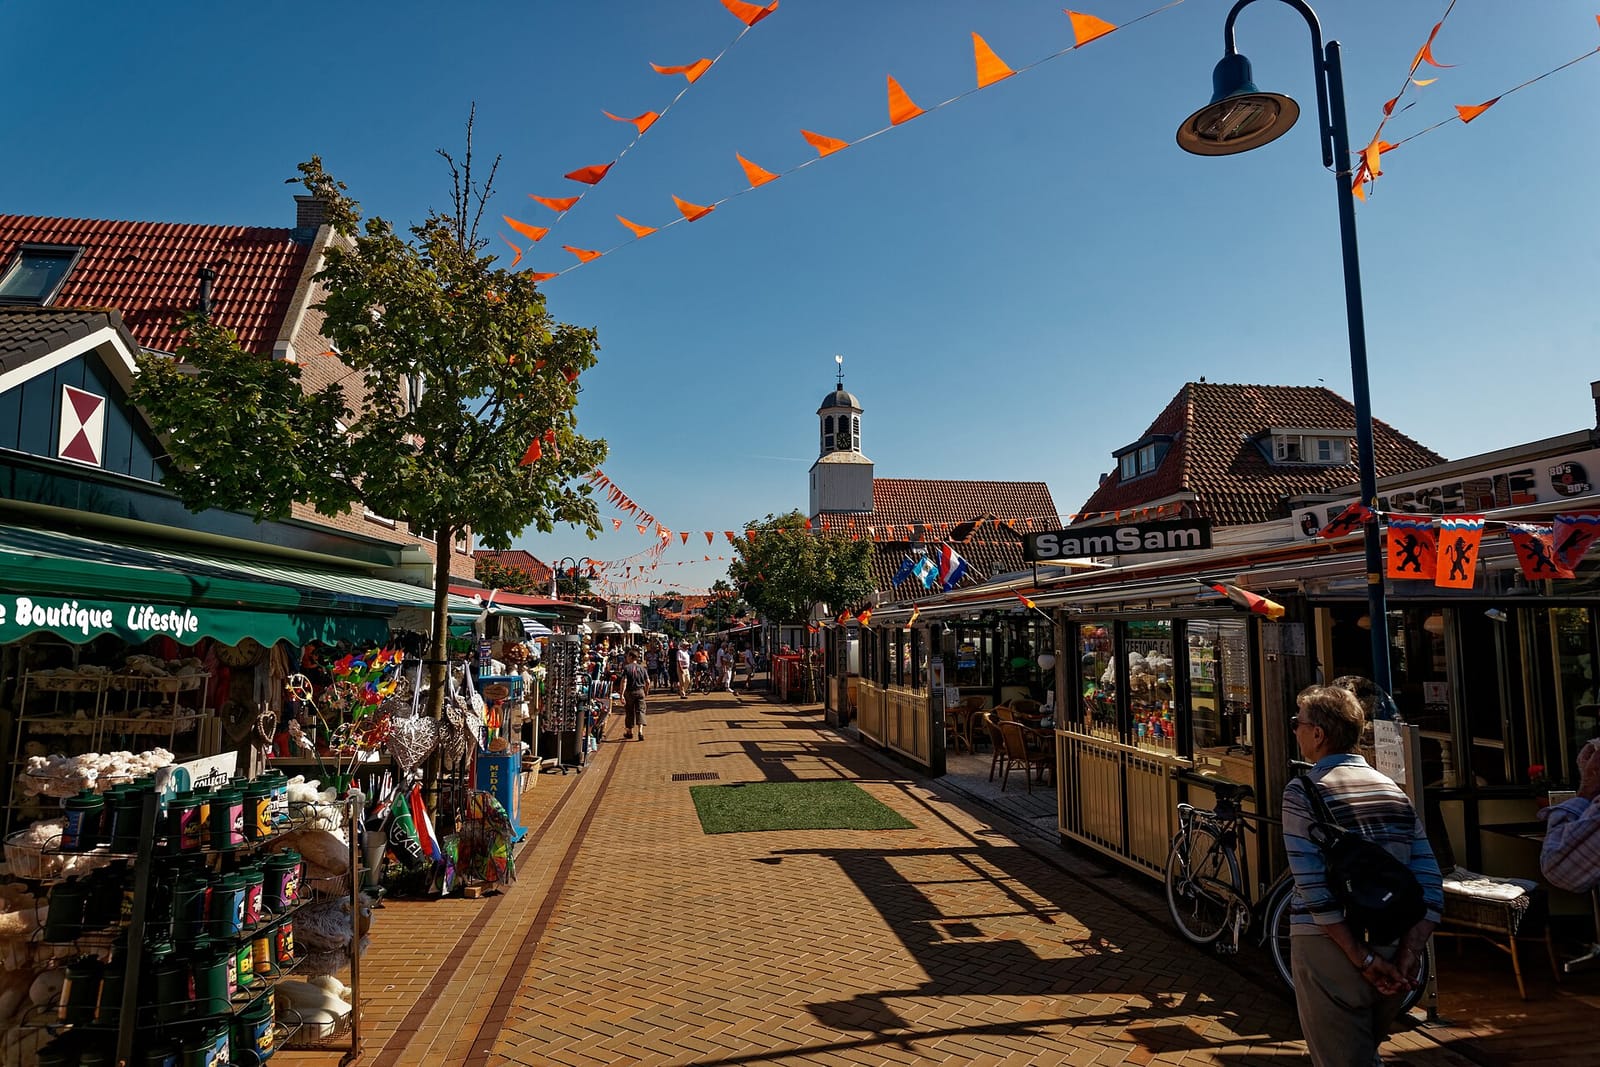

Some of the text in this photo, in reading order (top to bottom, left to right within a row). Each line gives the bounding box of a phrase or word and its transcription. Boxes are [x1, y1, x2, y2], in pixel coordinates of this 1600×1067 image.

[1035, 526, 1202, 557] SamSam
[15, 597, 113, 636] Boutique
[127, 603, 199, 638] Lifestyle
[391, 821, 423, 859] TEXEL
